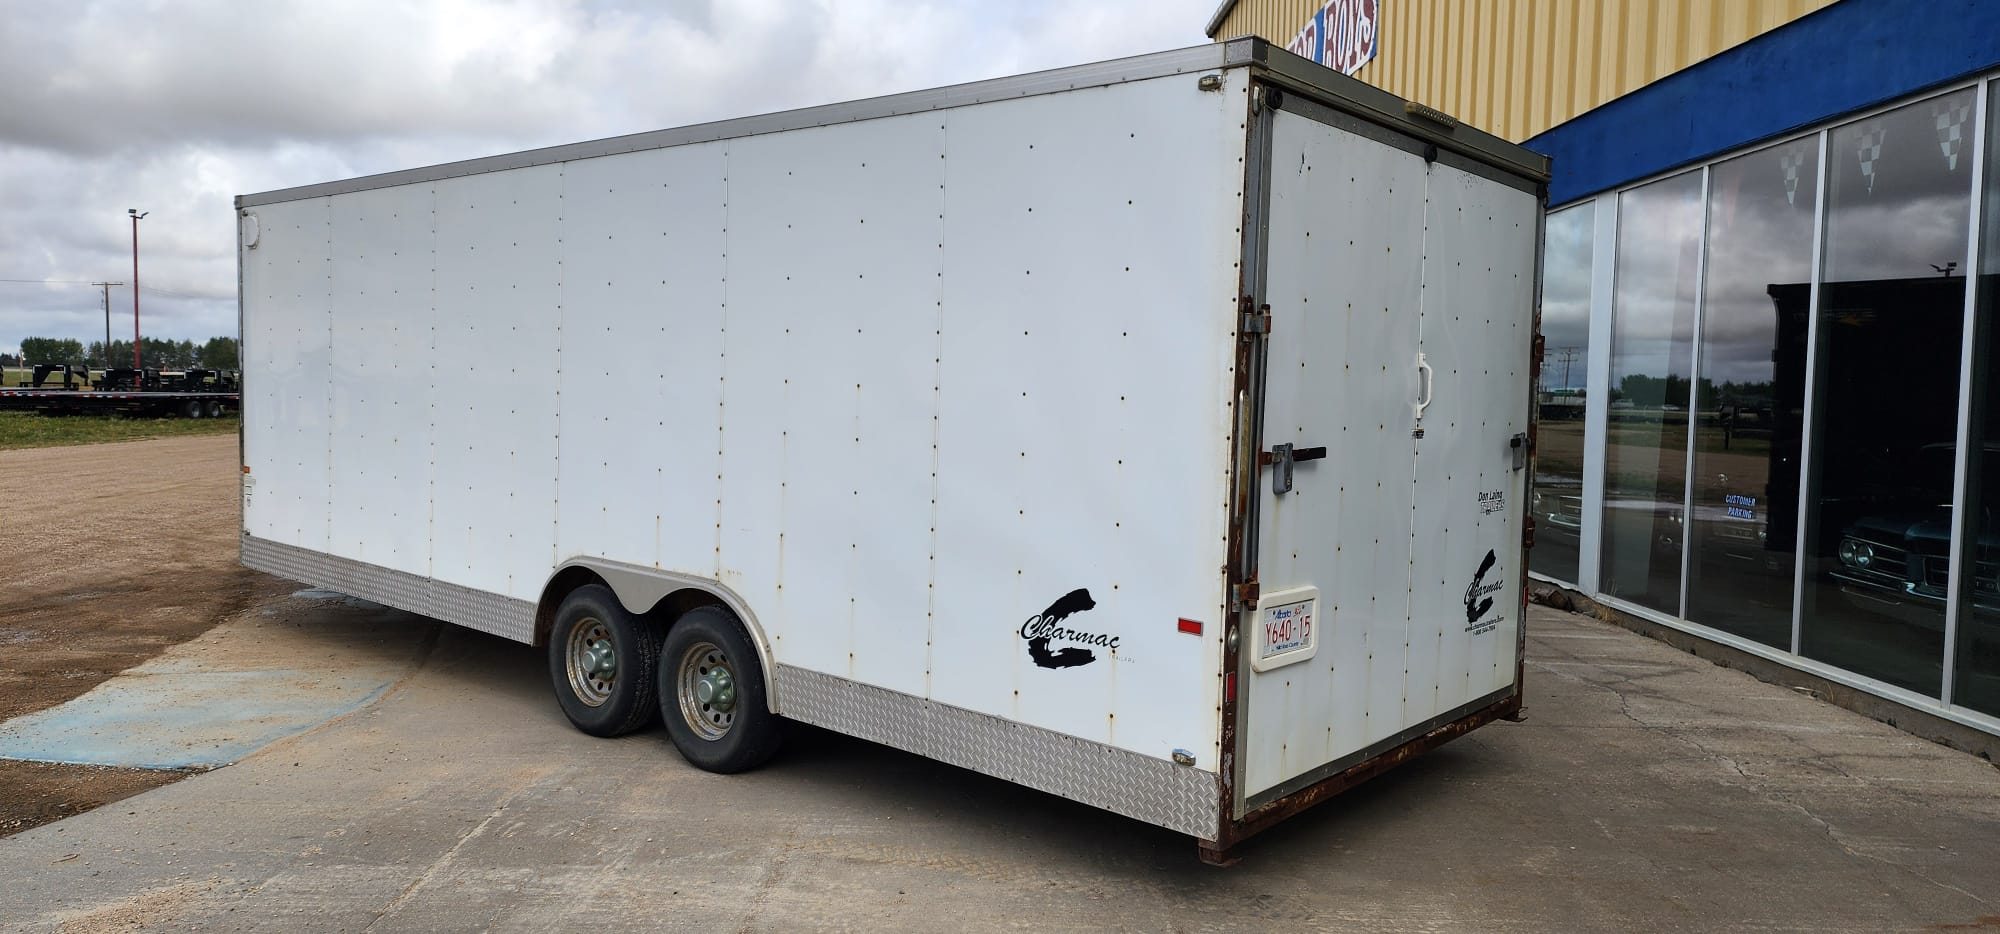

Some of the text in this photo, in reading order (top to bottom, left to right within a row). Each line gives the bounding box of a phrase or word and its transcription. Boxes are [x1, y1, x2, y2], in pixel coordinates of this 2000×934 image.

[1725, 495, 1756, 507] CUSTOMER
[1727, 506, 1753, 519] PARKING
[1464, 579, 1504, 605] Charmac
[1020, 614, 1120, 650] Charmac
